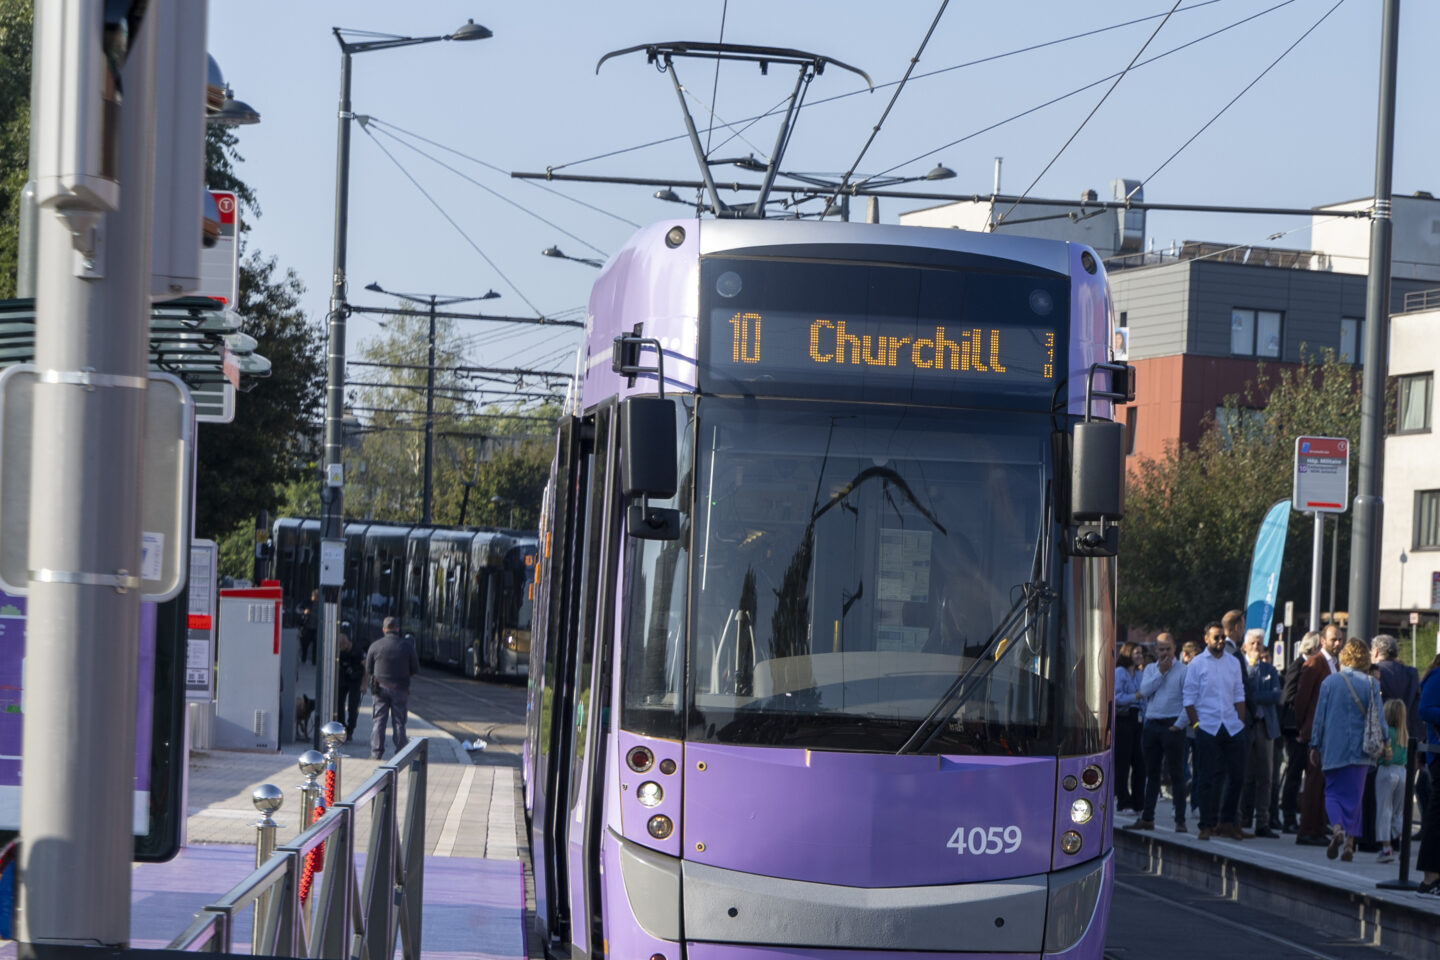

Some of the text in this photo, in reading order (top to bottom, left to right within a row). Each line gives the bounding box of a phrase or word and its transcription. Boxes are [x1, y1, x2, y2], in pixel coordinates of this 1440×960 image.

[729, 312, 1006, 373] 10 Churchill
[946, 825, 1022, 855] 4059
